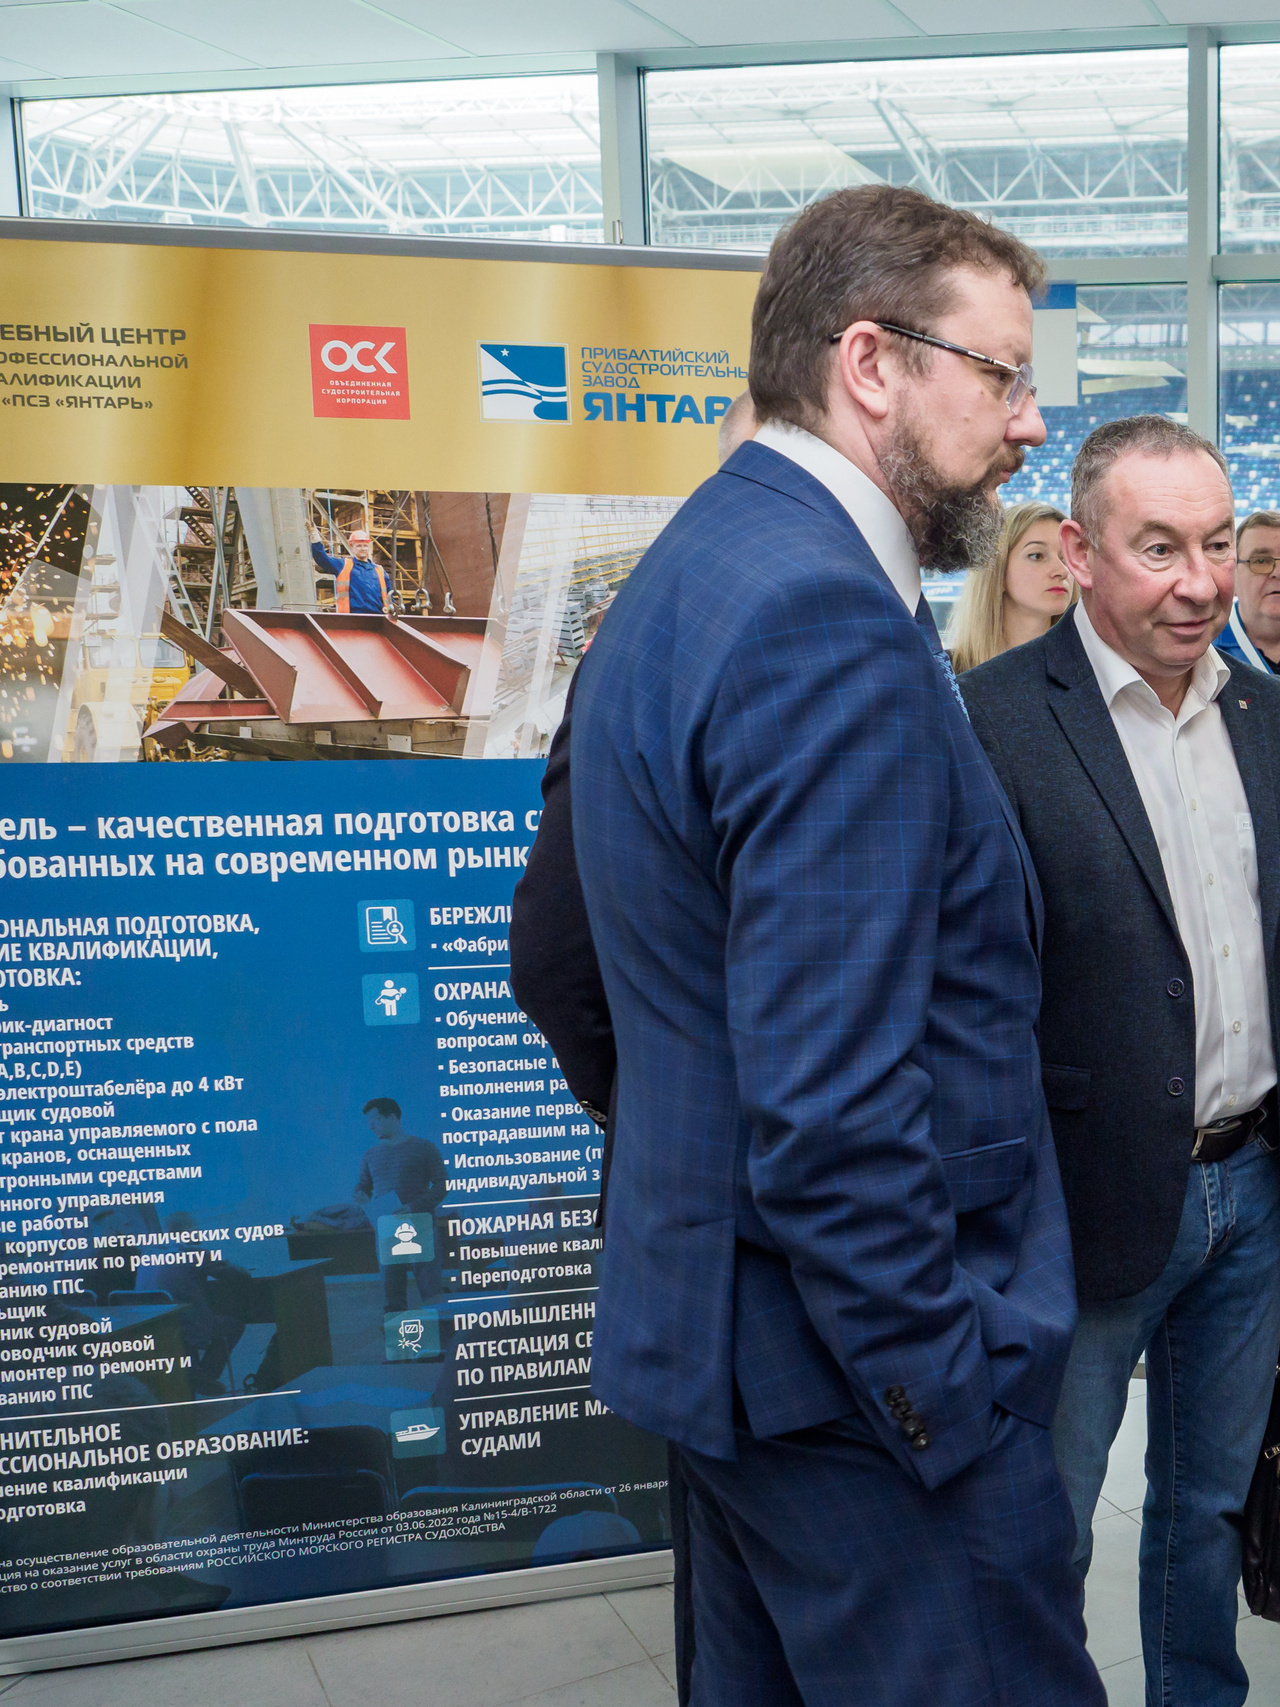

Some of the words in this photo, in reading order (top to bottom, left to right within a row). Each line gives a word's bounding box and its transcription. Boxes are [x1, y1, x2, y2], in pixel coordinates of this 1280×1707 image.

[101, 327, 187, 346] ЦЕНТР
[0, 351, 188, 369] ФЕССИОНАЛЬНОЙ
[321, 339, 397, 374] ОСК
[581, 346, 729, 364] ПРИБАЛТИЙСКИЙ
[321, 388, 401, 397] СУДОСТРОИТЕЛЬНАЯ
[329, 379, 392, 388] ОБЪЕДИНЕННАЯ
[582, 375, 640, 389] ЗАВОД
[3, 394, 50, 408] «ПСЗ
[55, 396, 153, 410] «ЯНТАРЬ»
[336, 397, 387, 405] КОРПОРАЦИЯ
[98, 814, 323, 839] качественная
[335, 810, 514, 841] подготовка
[166, 853, 204, 875] на
[215, 849, 437, 882] современном
[448, 847, 529, 877] рынк
[116, 914, 259, 939] ПОДГОТОВКА,
[29, 938, 218, 962] КВАЛИФИКАЦИИ,
[442, 936, 508, 956] «Фабри
[0, 968, 81, 988] ТОВКА:
[434, 981, 511, 1001] ОХРАНА
[0, 1018, 113, 1036] ик-диагност
[446, 1010, 527, 1029] Обучение
[127, 1037, 194, 1054] средств
[437, 1034, 517, 1052] вопросам
[449, 1058, 546, 1074] Безопасные
[171, 1081, 193, 1096] до
[199, 1077, 209, 1091] 4
[214, 1076, 244, 1091] кВт
[440, 1080, 544, 1097] выполнения
[42, 1101, 114, 1124] судовой
[452, 1106, 530, 1121] Оказание
[11, 1129, 63, 1147] крана
[69, 1123, 196, 1144] управляемого
[202, 1122, 210, 1133] с
[215, 1119, 257, 1133] пола
[443, 1126, 565, 1146] пострадавшим
[571, 1124, 589, 1135] на
[1, 1151, 71, 1169] кранов,
[77, 1144, 191, 1162] оснащенных
[455, 1150, 580, 1168] Использование
[99, 1166, 202, 1187] средствами
[445, 1167, 587, 1193] индивидуальной
[57, 1191, 164, 1213] управления
[22, 1215, 88, 1236] работы
[448, 1212, 554, 1236] ПОЖАРНАЯ
[6, 1238, 88, 1257] корпусов
[94, 1228, 230, 1248] металлических
[235, 1224, 284, 1243] судов
[460, 1242, 558, 1260] Повышение
[103, 1256, 124, 1268] по
[130, 1251, 205, 1271] ремонту
[210, 1250, 222, 1261] и
[462, 1264, 591, 1287] Переподготовка
[53, 1279, 85, 1295] ГПС
[454, 1302, 595, 1330] ПРОМЫШЛЕНН
[39, 1317, 112, 1342] судовой
[1, 1345, 77, 1363] оводчик
[82, 1335, 155, 1359] судовой
[455, 1334, 568, 1360] АТТЕСТАЦИЯ
[1, 1367, 67, 1382] монтер
[72, 1364, 94, 1377] по
[100, 1358, 174, 1379] ремонту
[180, 1356, 191, 1368] и
[457, 1368, 484, 1386] ПО
[62, 1384, 93, 1400] ГПС
[459, 1402, 578, 1430] УПРАВЛЕНИЕ
[0, 1423, 121, 1450] НИТЕЛЬНОЕ
[157, 1428, 309, 1459] ОБРАЗОВАНИЕ:
[462, 1431, 540, 1457] СУДАМИ
[0, 1482, 47, 1497] ение
[53, 1468, 187, 1492] квалификации
[16, 1549, 108, 1567] осуществление
[112, 1534, 216, 1555] образовательной
[220, 1526, 298, 1543] деятельности
[303, 1516, 383, 1531] Министерства
[386, 1506, 458, 1521] образования
[462, 1492, 557, 1511] Калининградской
[560, 1489, 601, 1499] области
[619, 1483, 631, 1492] 26
[41, 1572, 121, 1588] соответствии
[125, 1562, 204, 1580] требованиям
[207, 1549, 295, 1568] РОССИЙСКОГО
[300, 1540, 363, 1555] МОРСКОГО
[367, 1533, 422, 1547] РЕГИСТРА
[425, 1522, 505, 1540] СУДОХОДСТВА
[43, 1563, 98, 1575] оказание
[102, 1559, 132, 1571] услуг
[146, 1551, 193, 1563] области
[196, 1546, 240, 1557] охраны
[243, 1541, 275, 1554] труда
[279, 1533, 335, 1546] Минтруда
[339, 1528, 378, 1538] России
[396, 1517, 454, 1531] 03.06.2022
[457, 1515, 480, 1524] года
